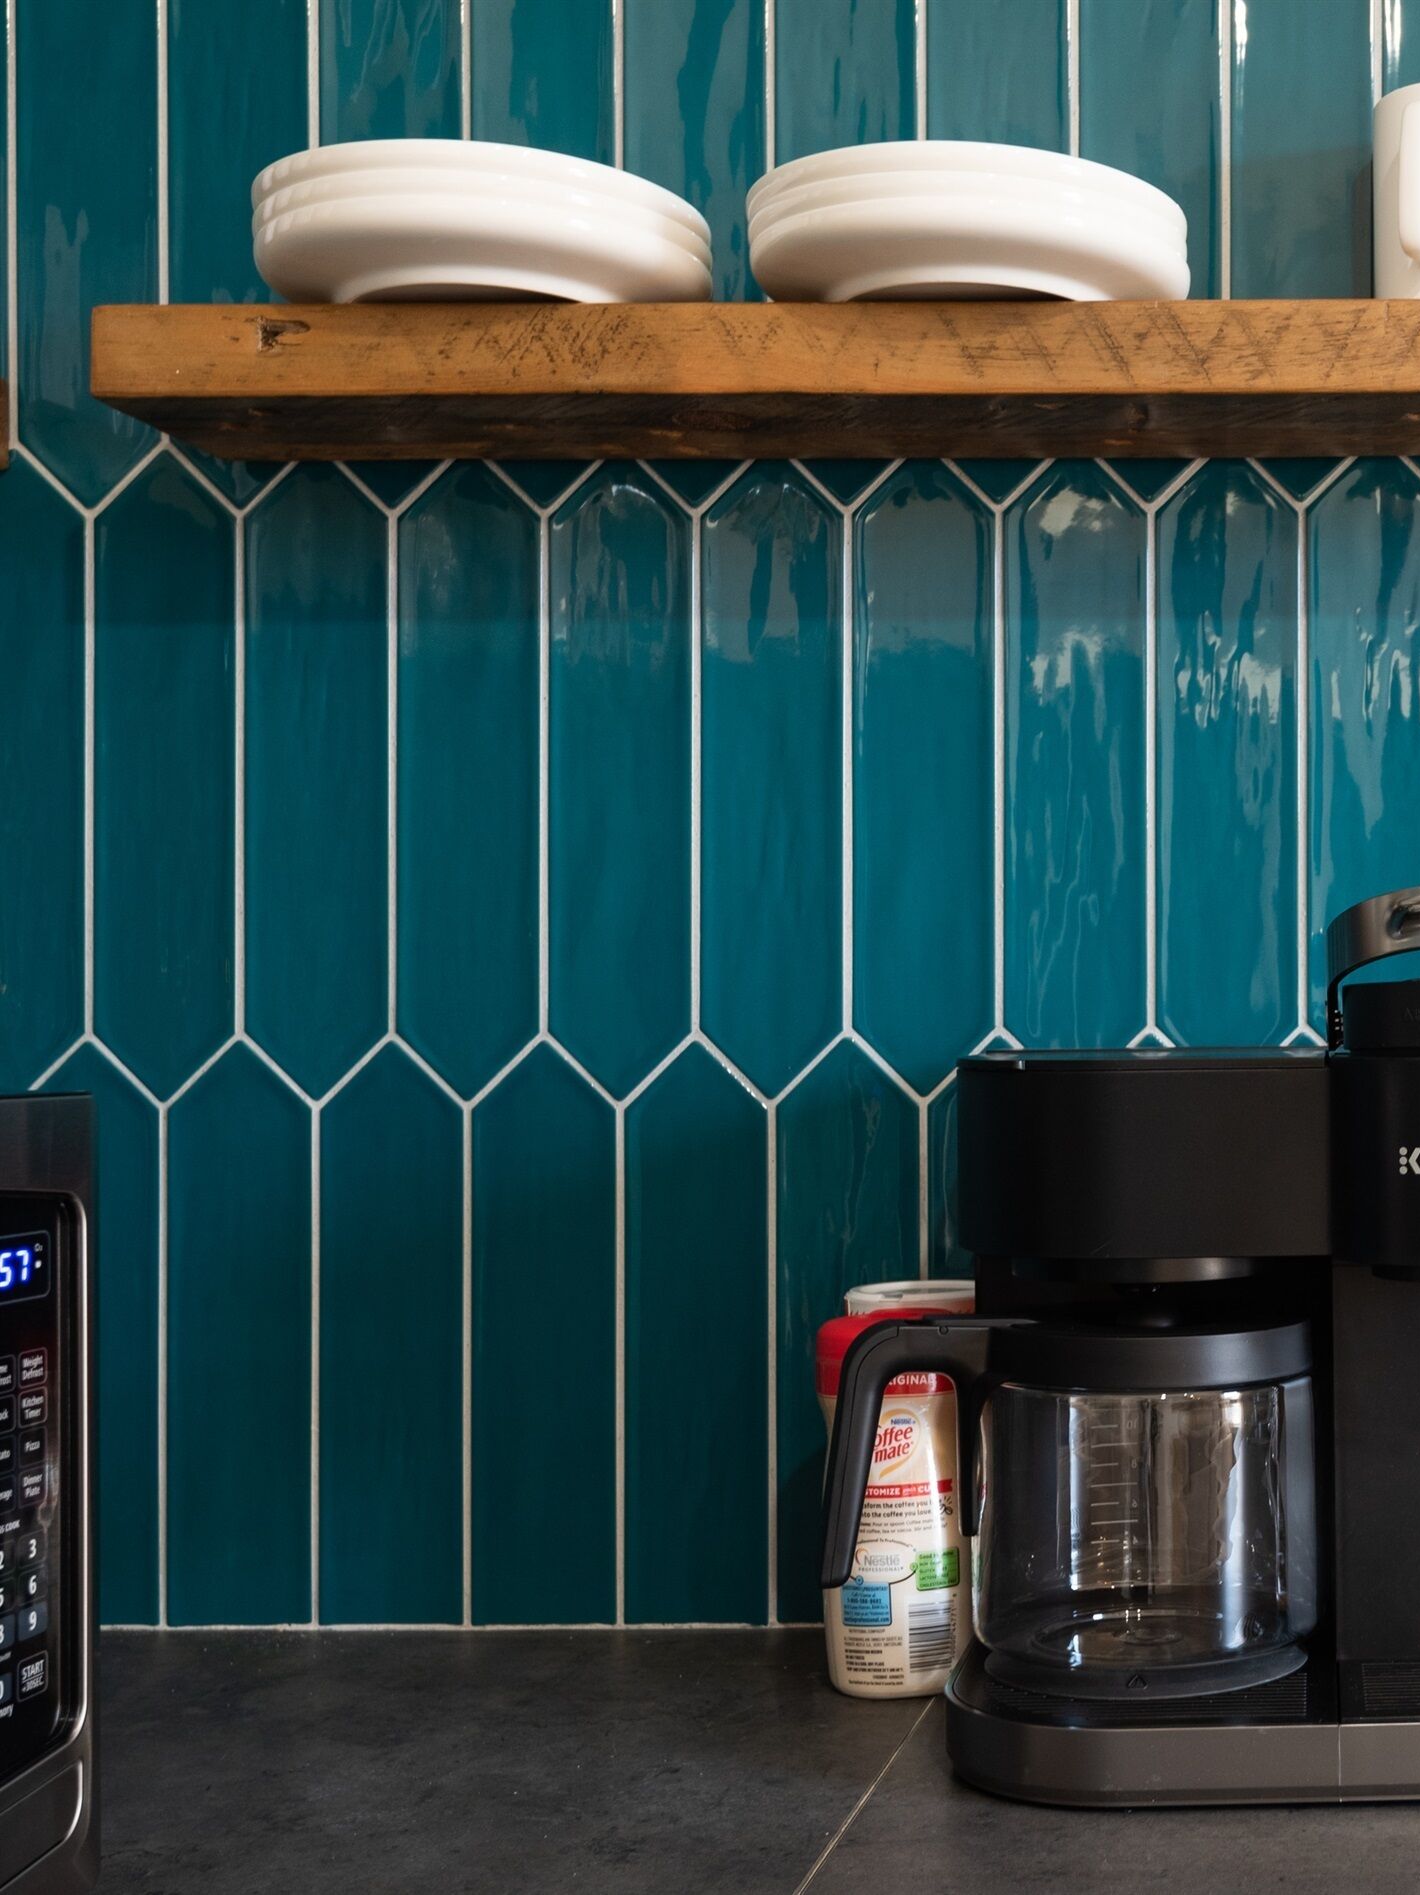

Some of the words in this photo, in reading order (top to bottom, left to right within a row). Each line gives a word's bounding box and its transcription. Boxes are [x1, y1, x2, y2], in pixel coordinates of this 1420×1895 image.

[22, 1355, 43, 1370] Weight
[22, 1367, 44, 1381] Defrost
[889, 1375, 936, 1386] IGINA
[22, 1396, 44, 1409] Kitchen
[25, 1408, 42, 1420] Timer
[874, 1426, 913, 1449] offee
[25, 1441, 40, 1452] Pizza
[23, 1474, 43, 1487] Dinner
[25, 1486, 41, 1498] Plate
[865, 1487, 901, 1497] STOMIZE
[895, 1500, 915, 1509] coffee
[883, 1508, 903, 1517] coffee
[29, 1538, 37, 1558] 3
[29, 1575, 37, 1595] 6
[29, 1611, 37, 1631] 9
[22, 1659, 45, 1681] START
